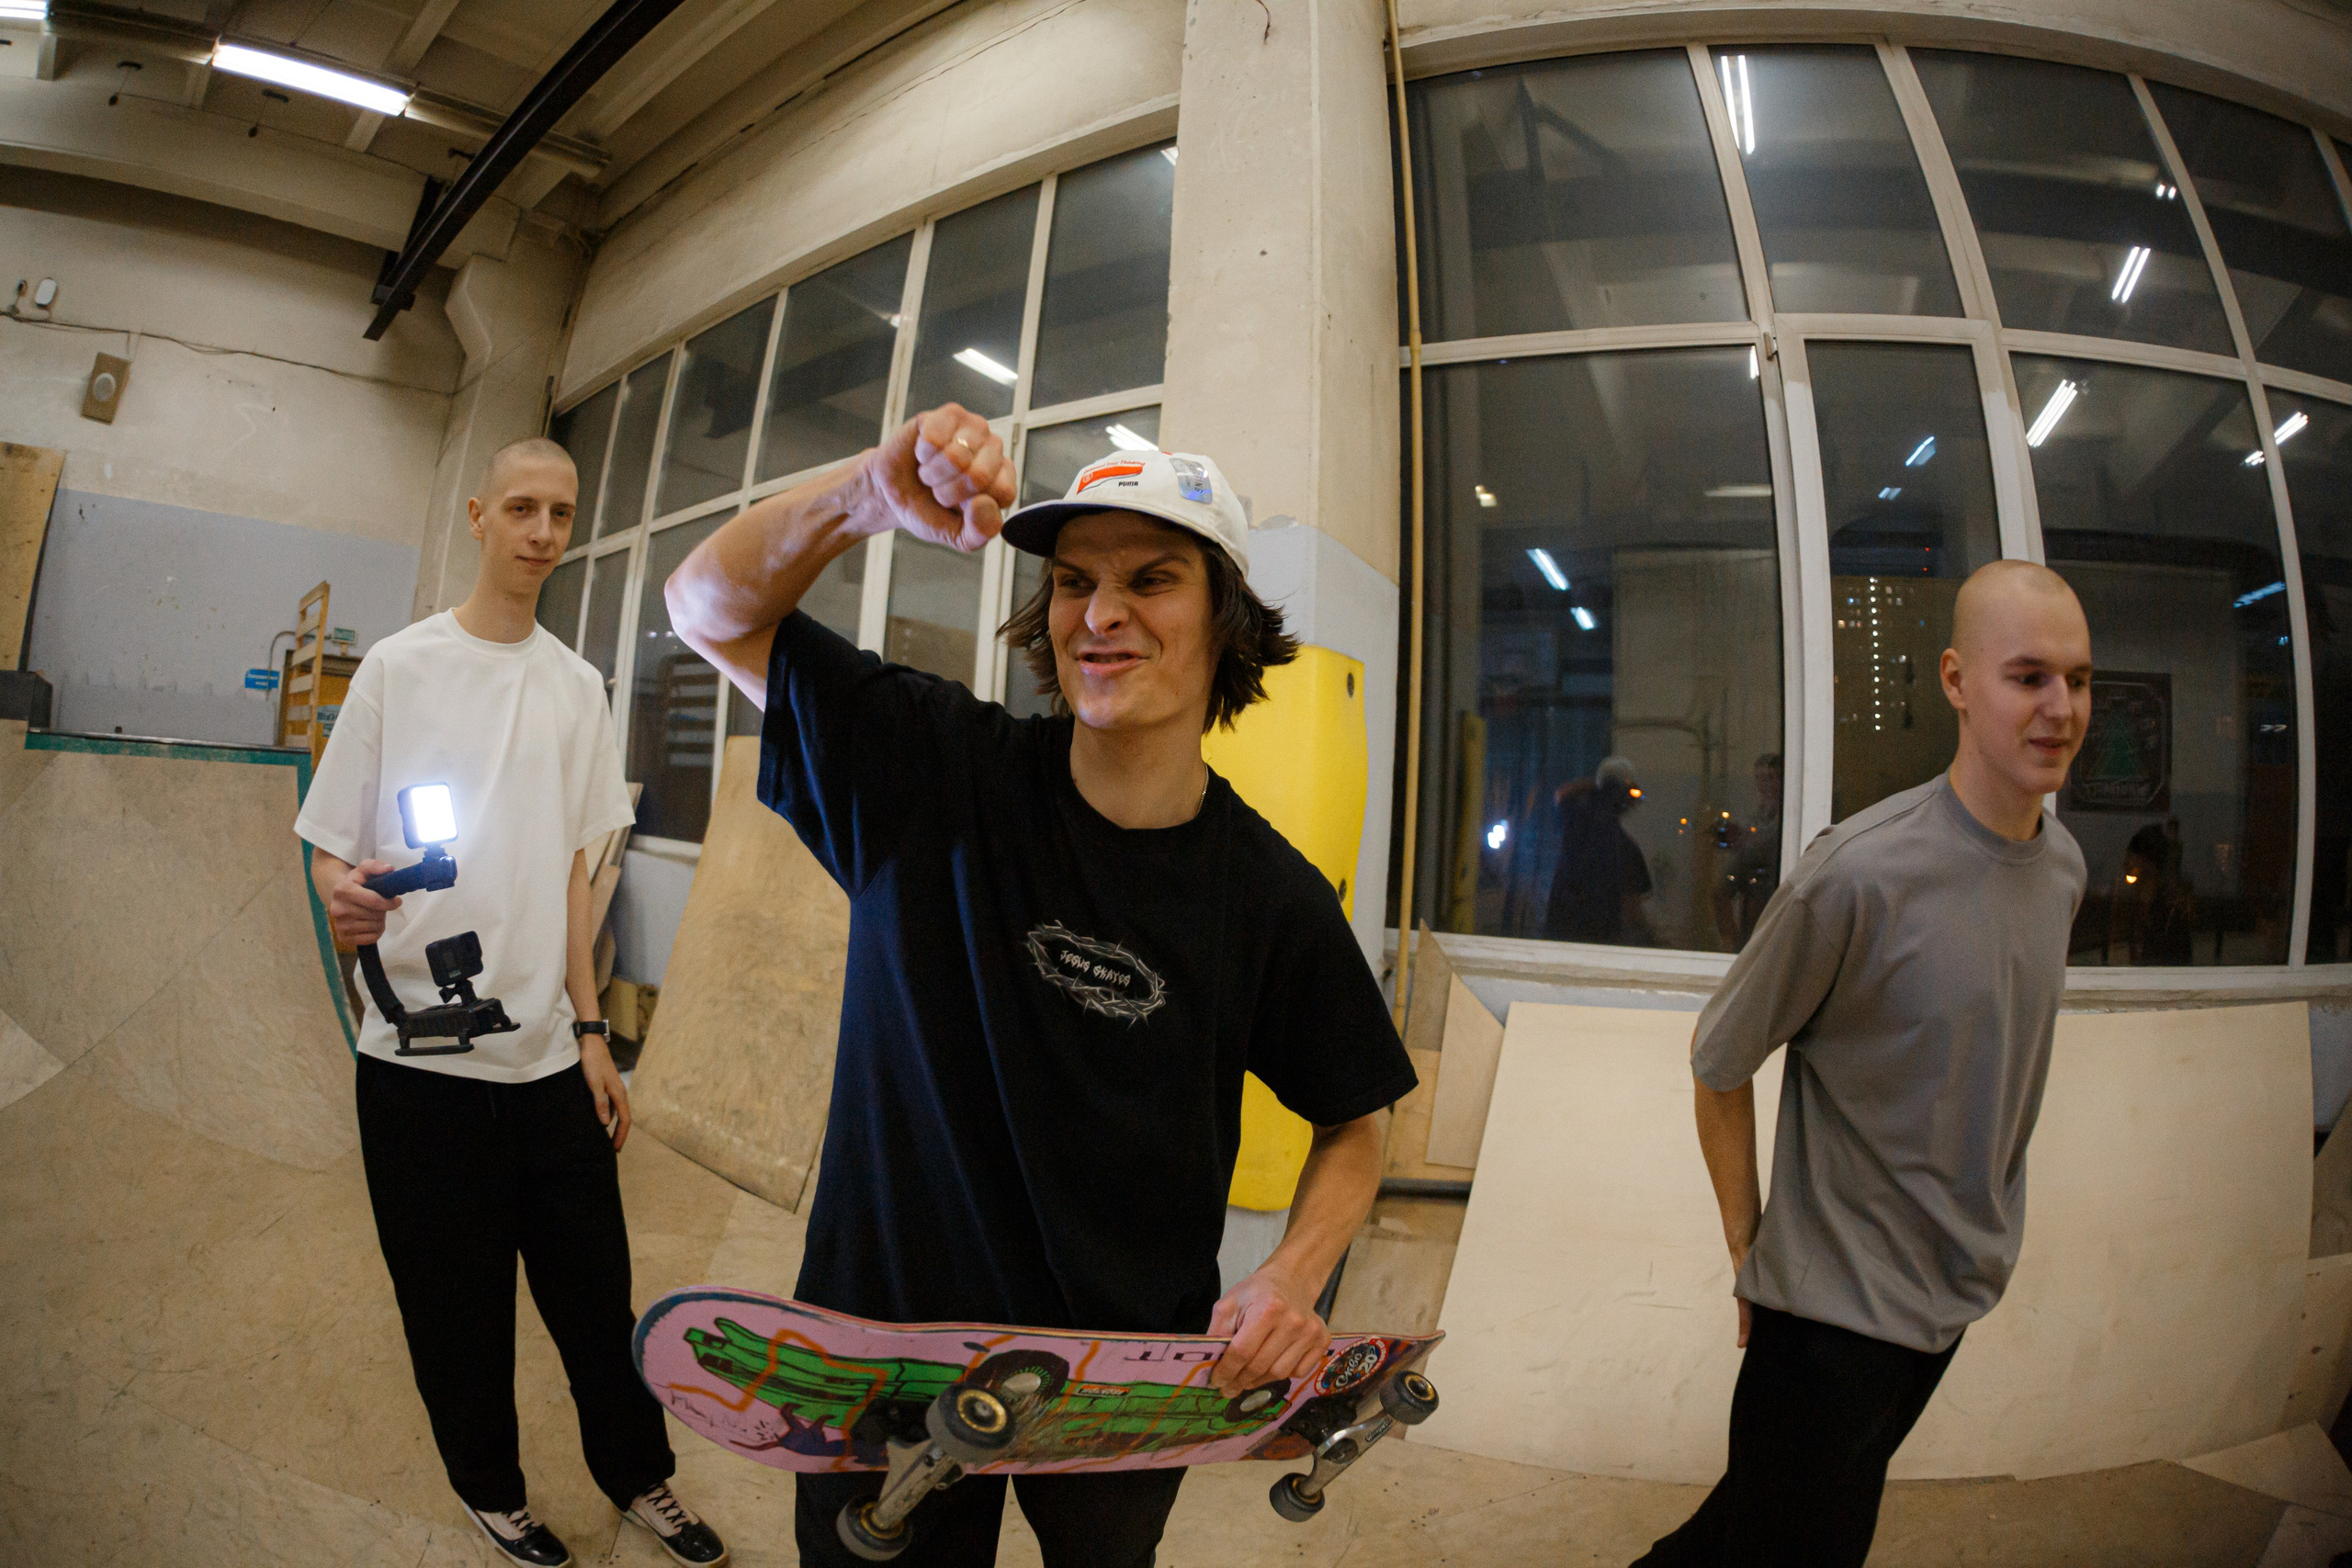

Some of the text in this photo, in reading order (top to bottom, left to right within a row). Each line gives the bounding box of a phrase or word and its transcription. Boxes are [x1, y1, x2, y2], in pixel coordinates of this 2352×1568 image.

[1059, 950, 1132, 987] JESUS SKATES
[1358, 1354, 1378, 1374] 20
